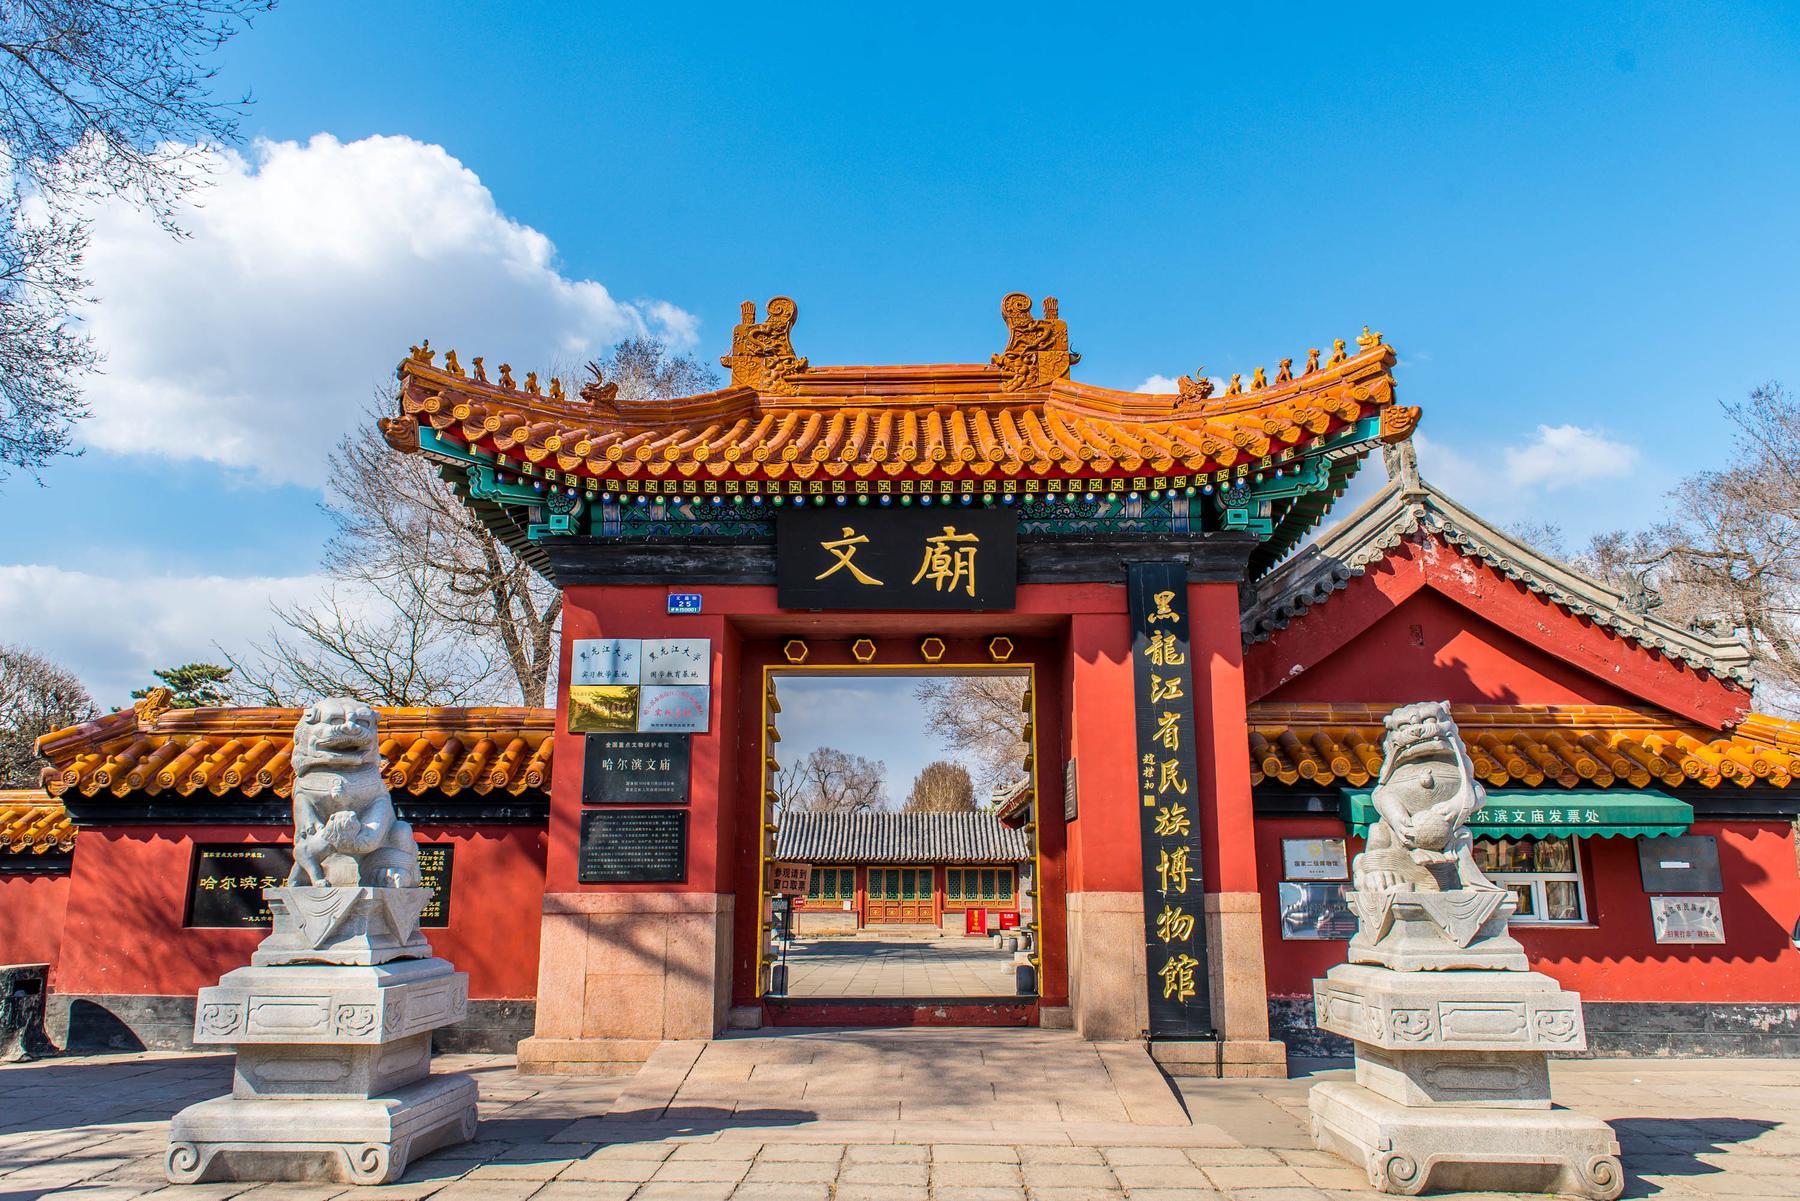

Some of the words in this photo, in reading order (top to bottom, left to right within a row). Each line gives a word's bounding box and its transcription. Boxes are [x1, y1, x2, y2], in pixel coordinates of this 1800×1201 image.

[815, 525, 980, 597] 文廟
[678, 600, 692, 608] 25
[602, 757, 671, 771] 哈尔滨文庙
[1143, 590, 1201, 1004] 黑龍江省民族博物館
[775, 867, 807, 880] 参观请到
